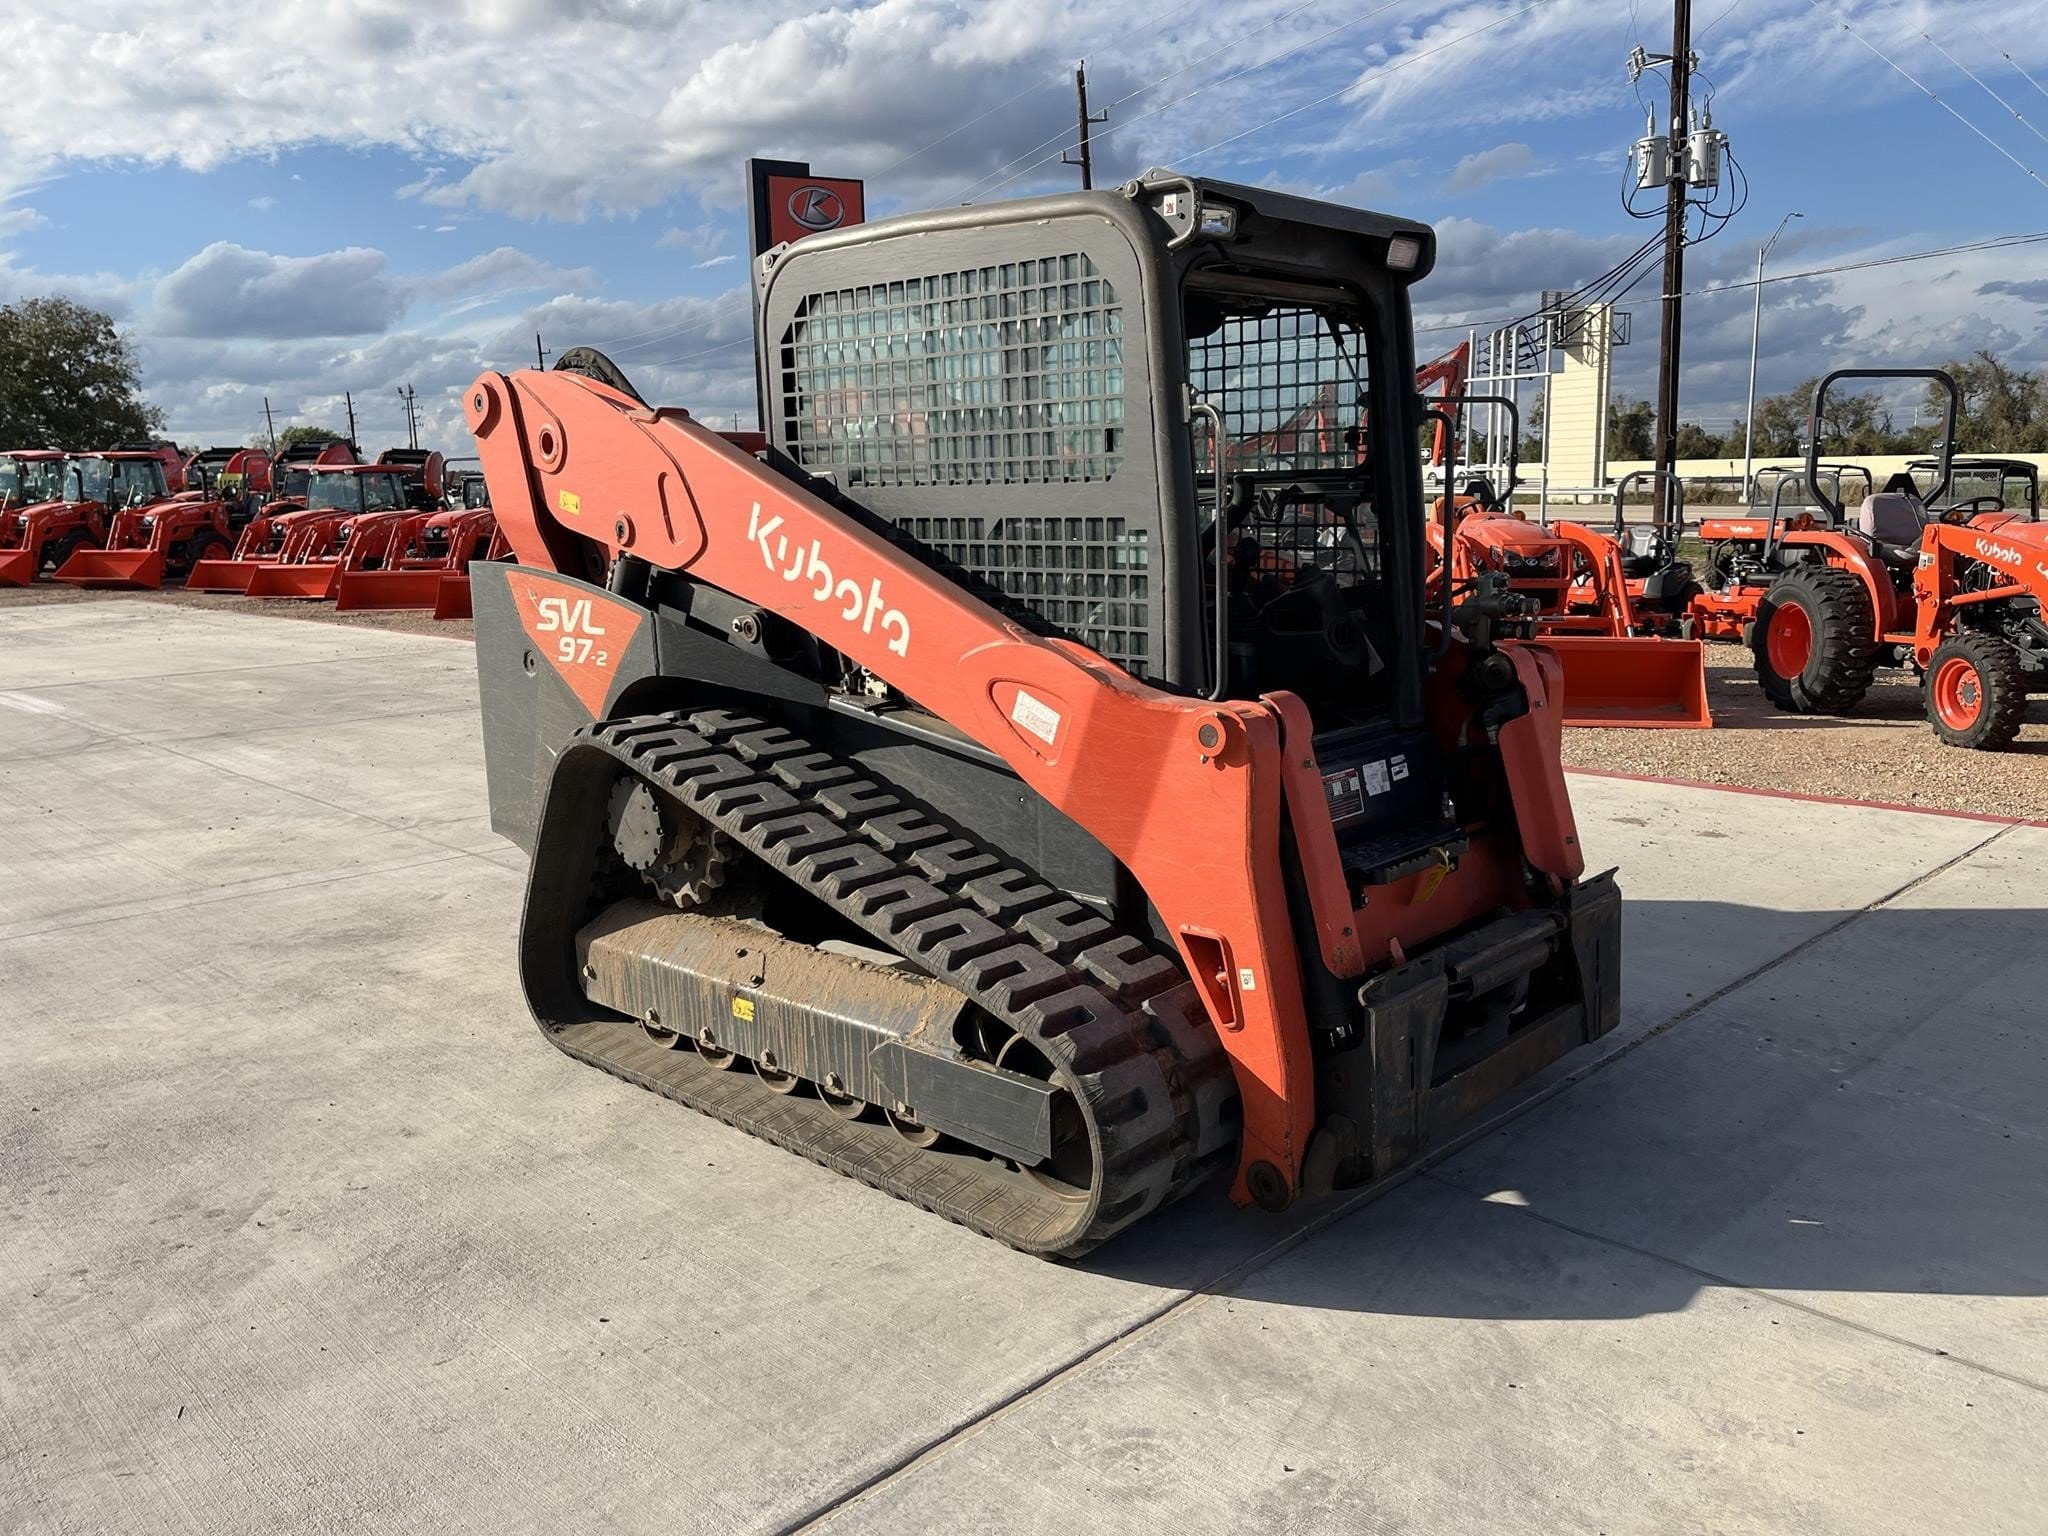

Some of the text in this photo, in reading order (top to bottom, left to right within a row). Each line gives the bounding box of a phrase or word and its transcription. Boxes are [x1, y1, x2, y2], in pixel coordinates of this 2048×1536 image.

[1975, 537, 2022, 566] Kubota
[747, 501, 911, 658] Kubota
[536, 597, 606, 636] SVL
[558, 636, 608, 667] 97-2
